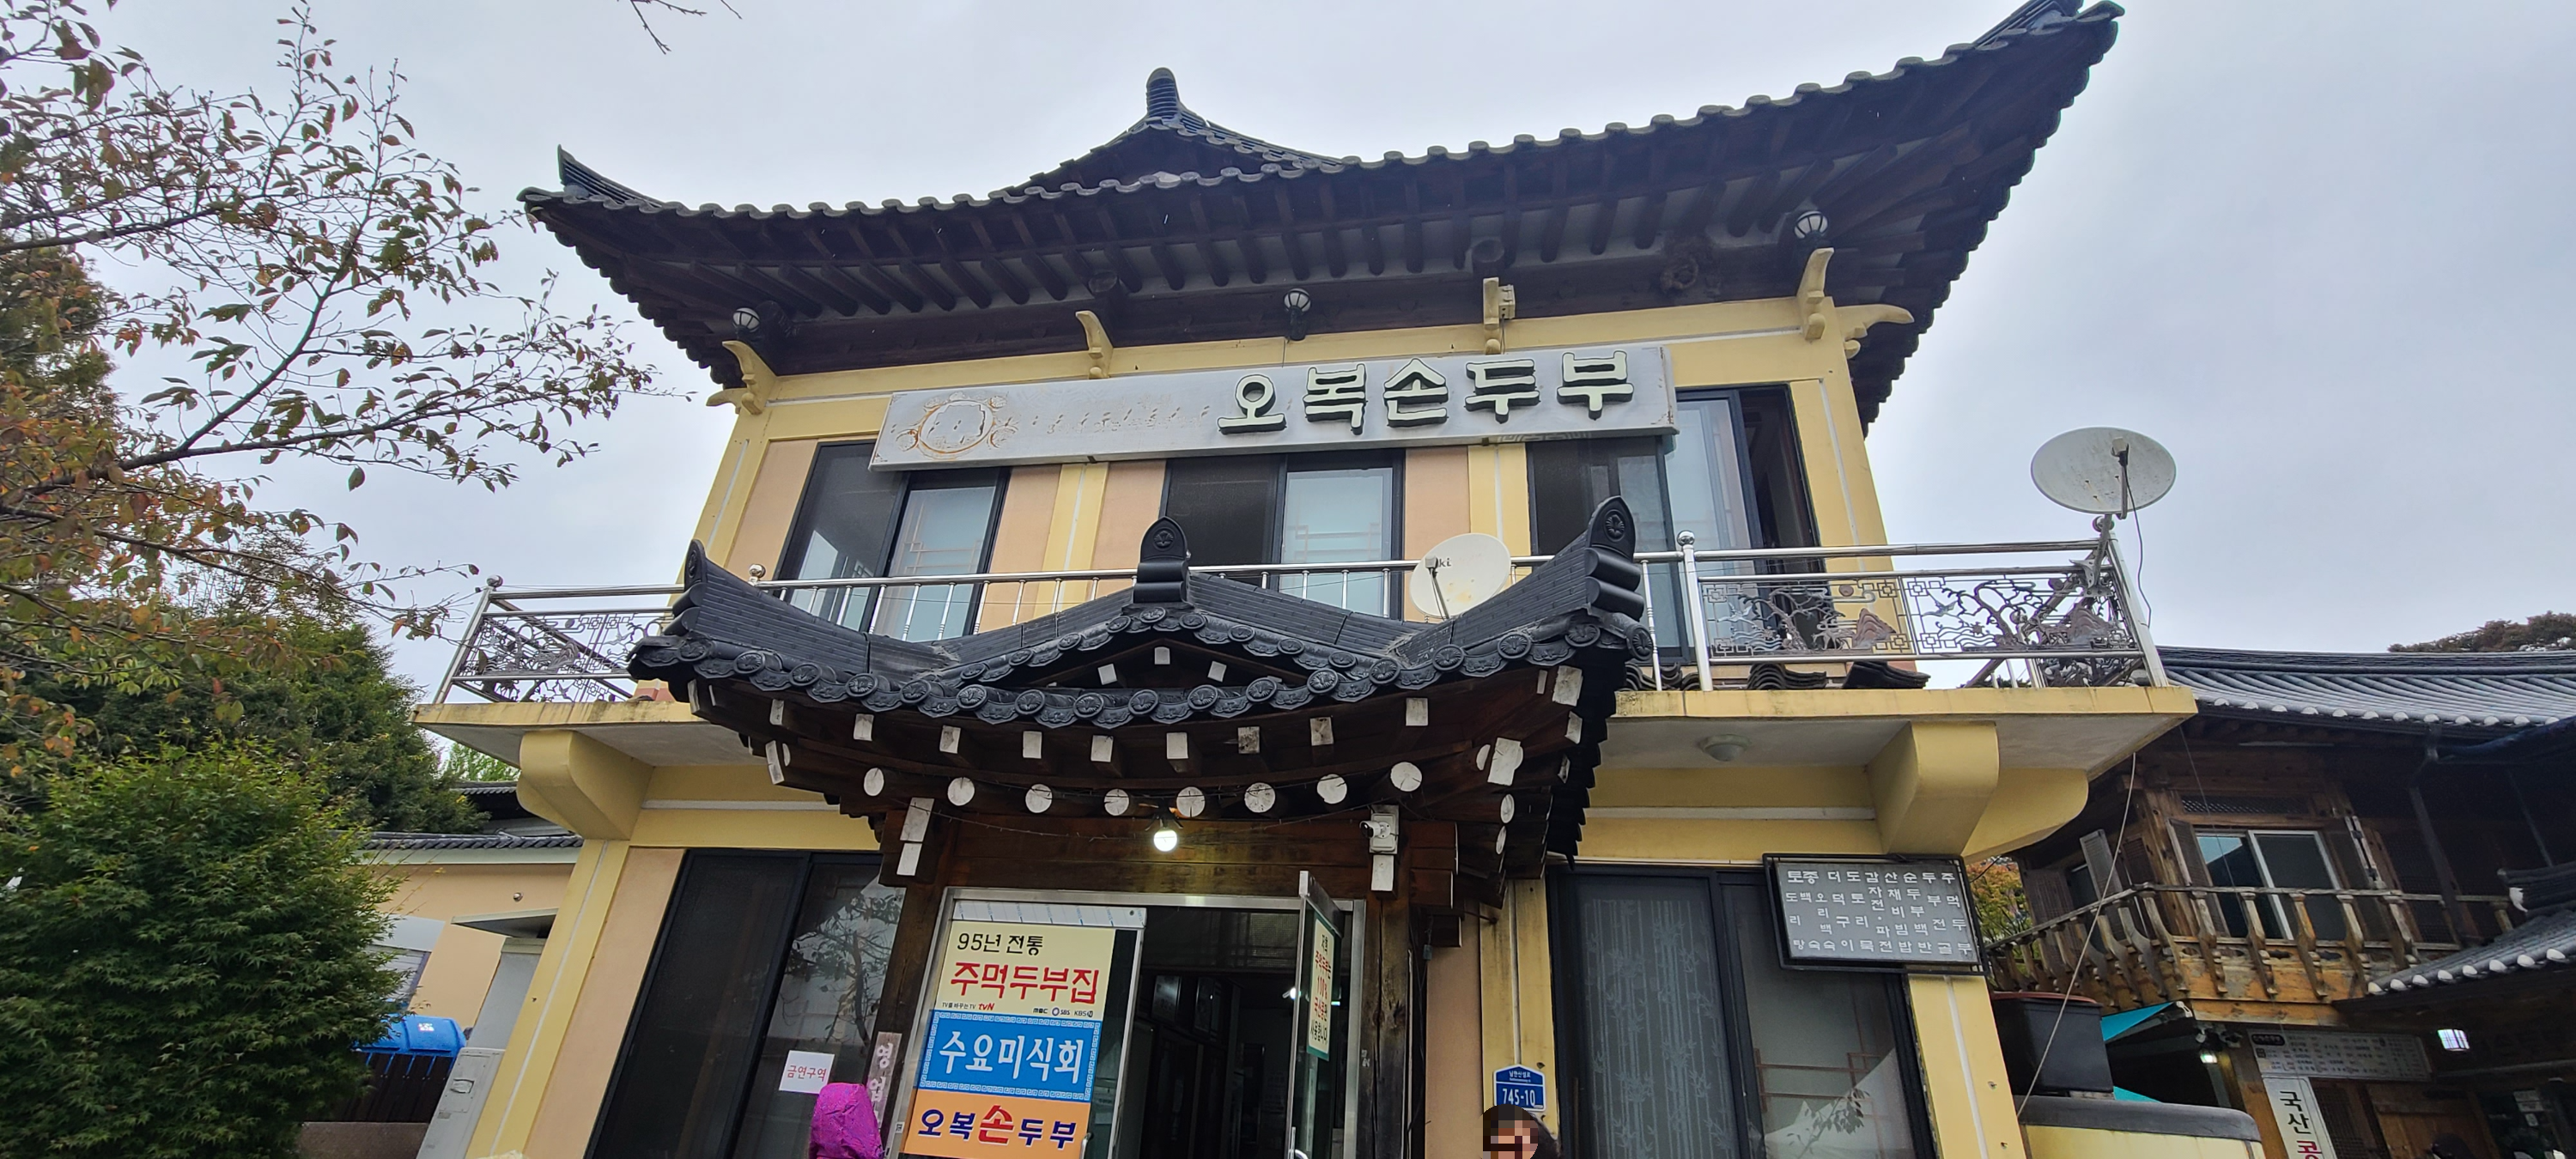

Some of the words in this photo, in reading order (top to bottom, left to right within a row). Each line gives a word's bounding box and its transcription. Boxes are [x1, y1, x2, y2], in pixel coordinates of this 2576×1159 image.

[1218, 350, 1634, 435] 오복손두부
[1787, 870, 1820, 884] 토종
[1800, 891, 1820, 951] 백숙
[1815, 892, 1836, 951] 오리백숙
[1827, 871, 1854, 952] 더덕구이
[1846, 871, 1874, 952] 도토리묵
[1885, 871, 1912, 953] 산채비빔밥
[1903, 871, 1932, 954] 순두부백반
[1922, 872, 1953, 955] 두부전골
[1941, 872, 1972, 955] 주먹두부
[957, 932, 1001, 953] 95년
[1005, 935, 1044, 956] 전통
[950, 962, 1100, 1005] 주먹두부집
[978, 1002, 995, 1011] tvN
[787, 1065, 827, 1082] 금연구역
[939, 1030, 1084, 1083] 수요미식회
[1502, 1088, 1535, 1107] 745-10
[2279, 1090, 2312, 1134] 국산
[918, 1104, 1077, 1150] 오복손두부
